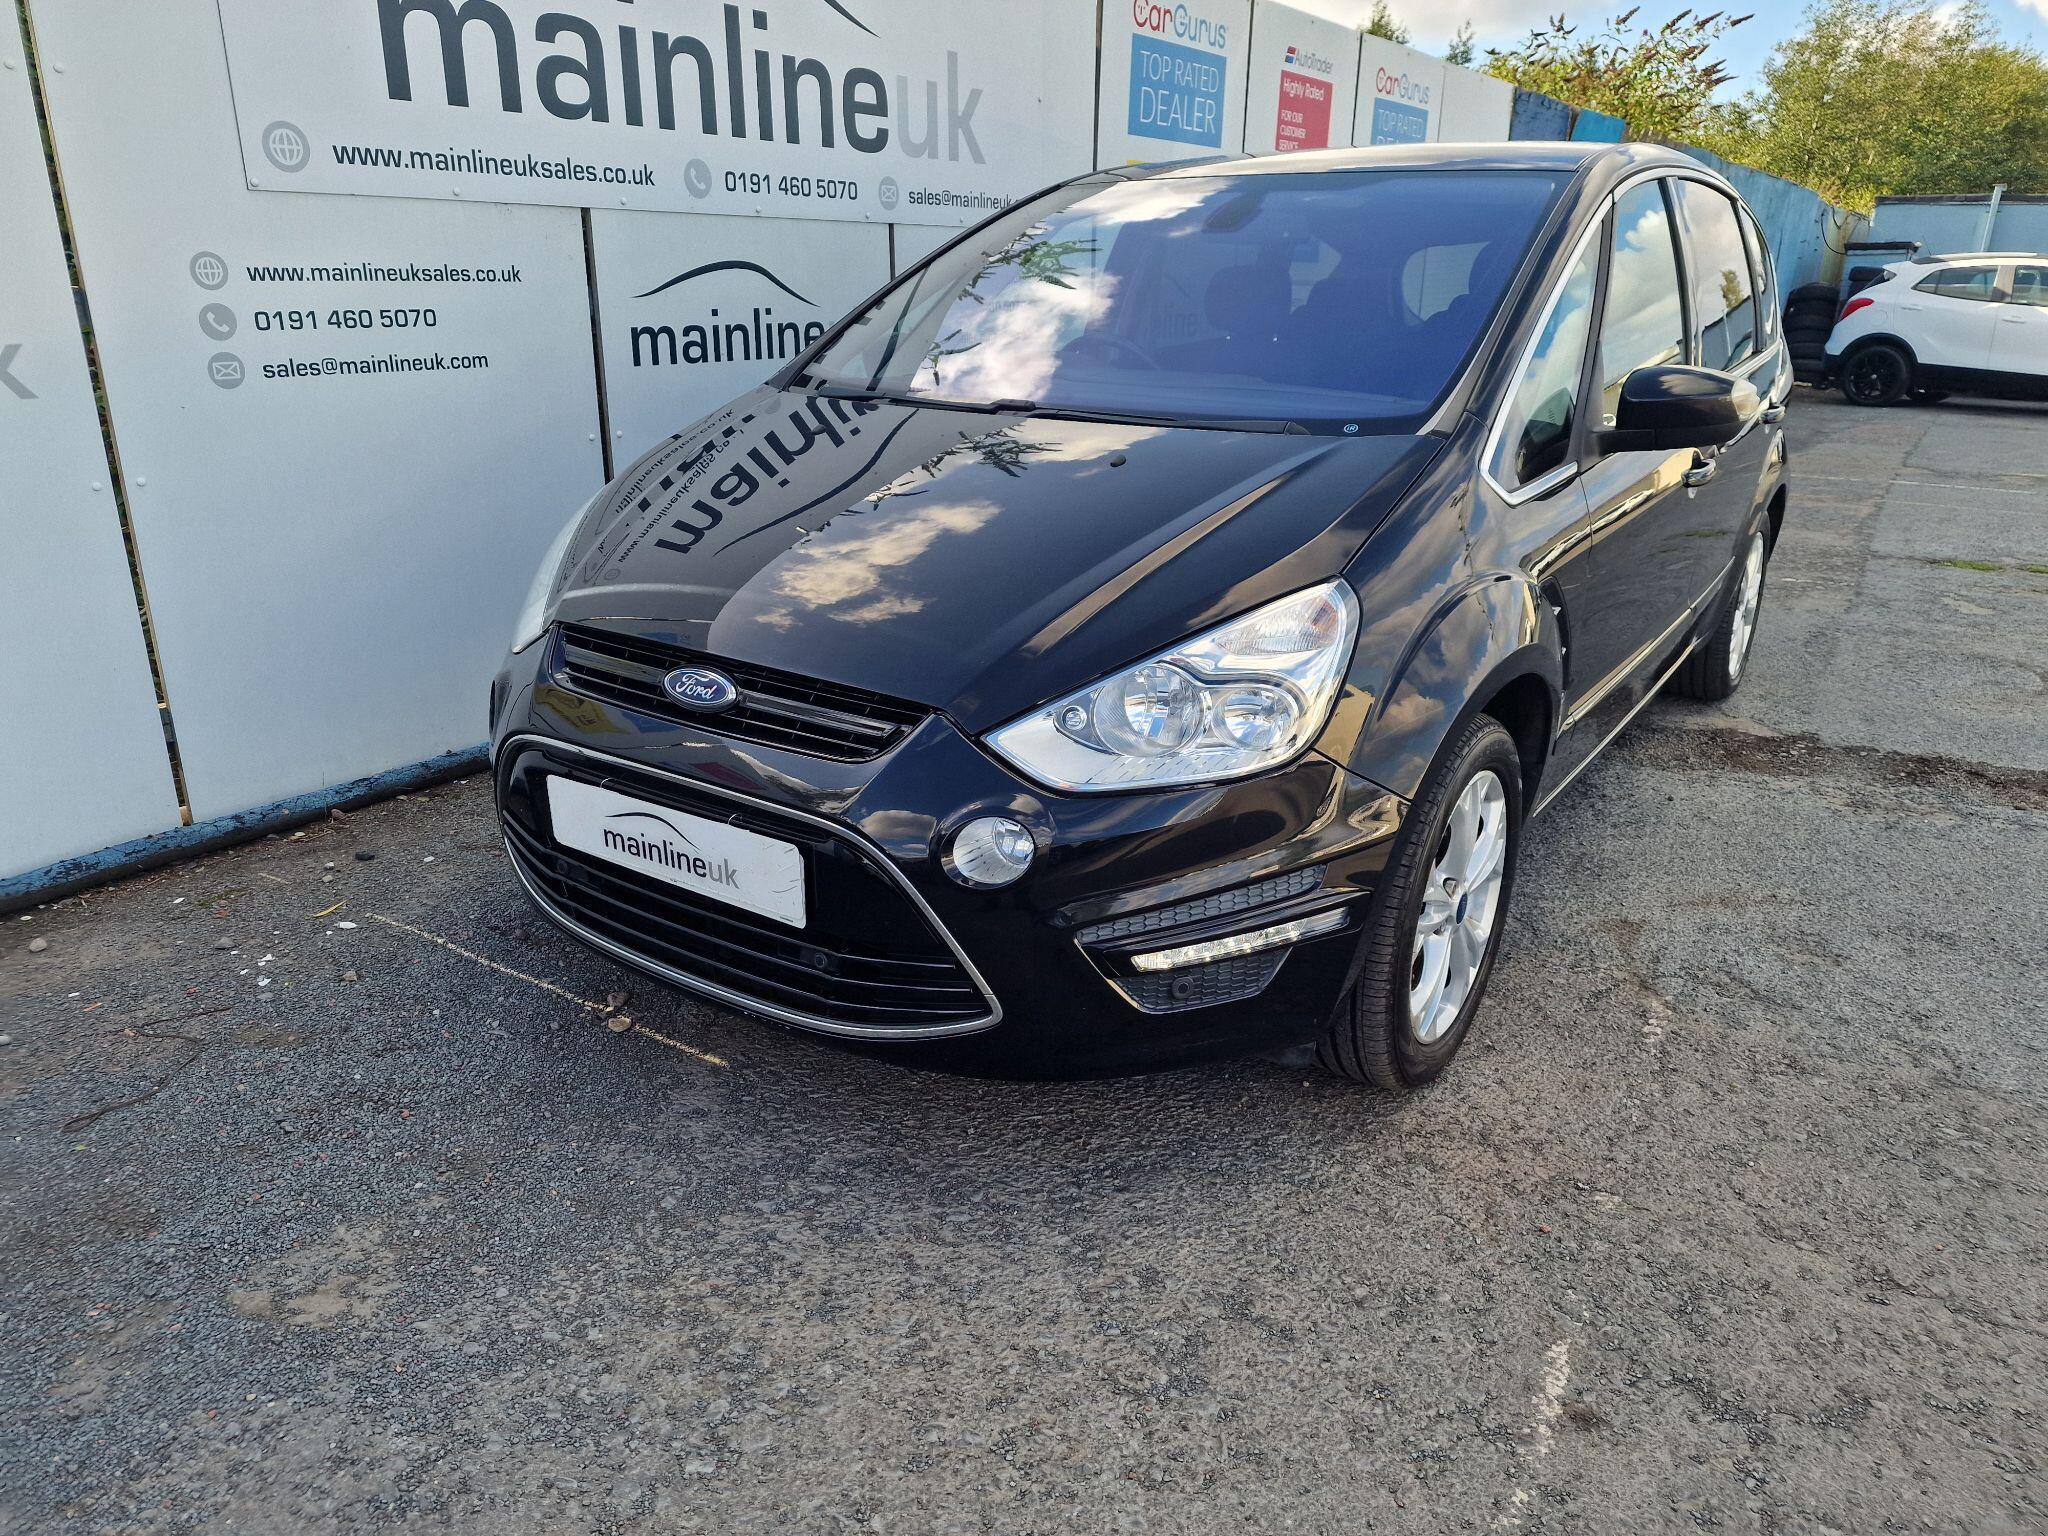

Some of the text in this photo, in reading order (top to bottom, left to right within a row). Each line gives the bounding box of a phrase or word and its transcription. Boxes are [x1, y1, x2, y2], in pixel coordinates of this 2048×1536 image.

[1133, 0, 1227, 49] CarGurus
[378, 0, 986, 165] mainlineuk
[1140, 50, 1219, 93] TOP RATED
[1376, 66, 1430, 105] CarGurus
[1283, 78, 1325, 101] Highly Rated
[1140, 86, 1216, 134] DEALER
[1281, 109, 1304, 123] FOR OUR
[1378, 109, 1424, 138] TOP RATED
[1280, 124, 1306, 138] CUSTOMER
[332, 144, 656, 186] www.mainlineuksales.co.uk
[724, 171, 858, 200] 0191 460 5070
[246, 262, 522, 283] www.mainlineuksales.co.uk
[254, 308, 437, 331] 0191 460 5070
[630, 307, 828, 367] mainline
[262, 352, 489, 379] sales@mainlineuk.com
[675, 673, 718, 700] Ford
[603, 828, 741, 889] mainlineuk
